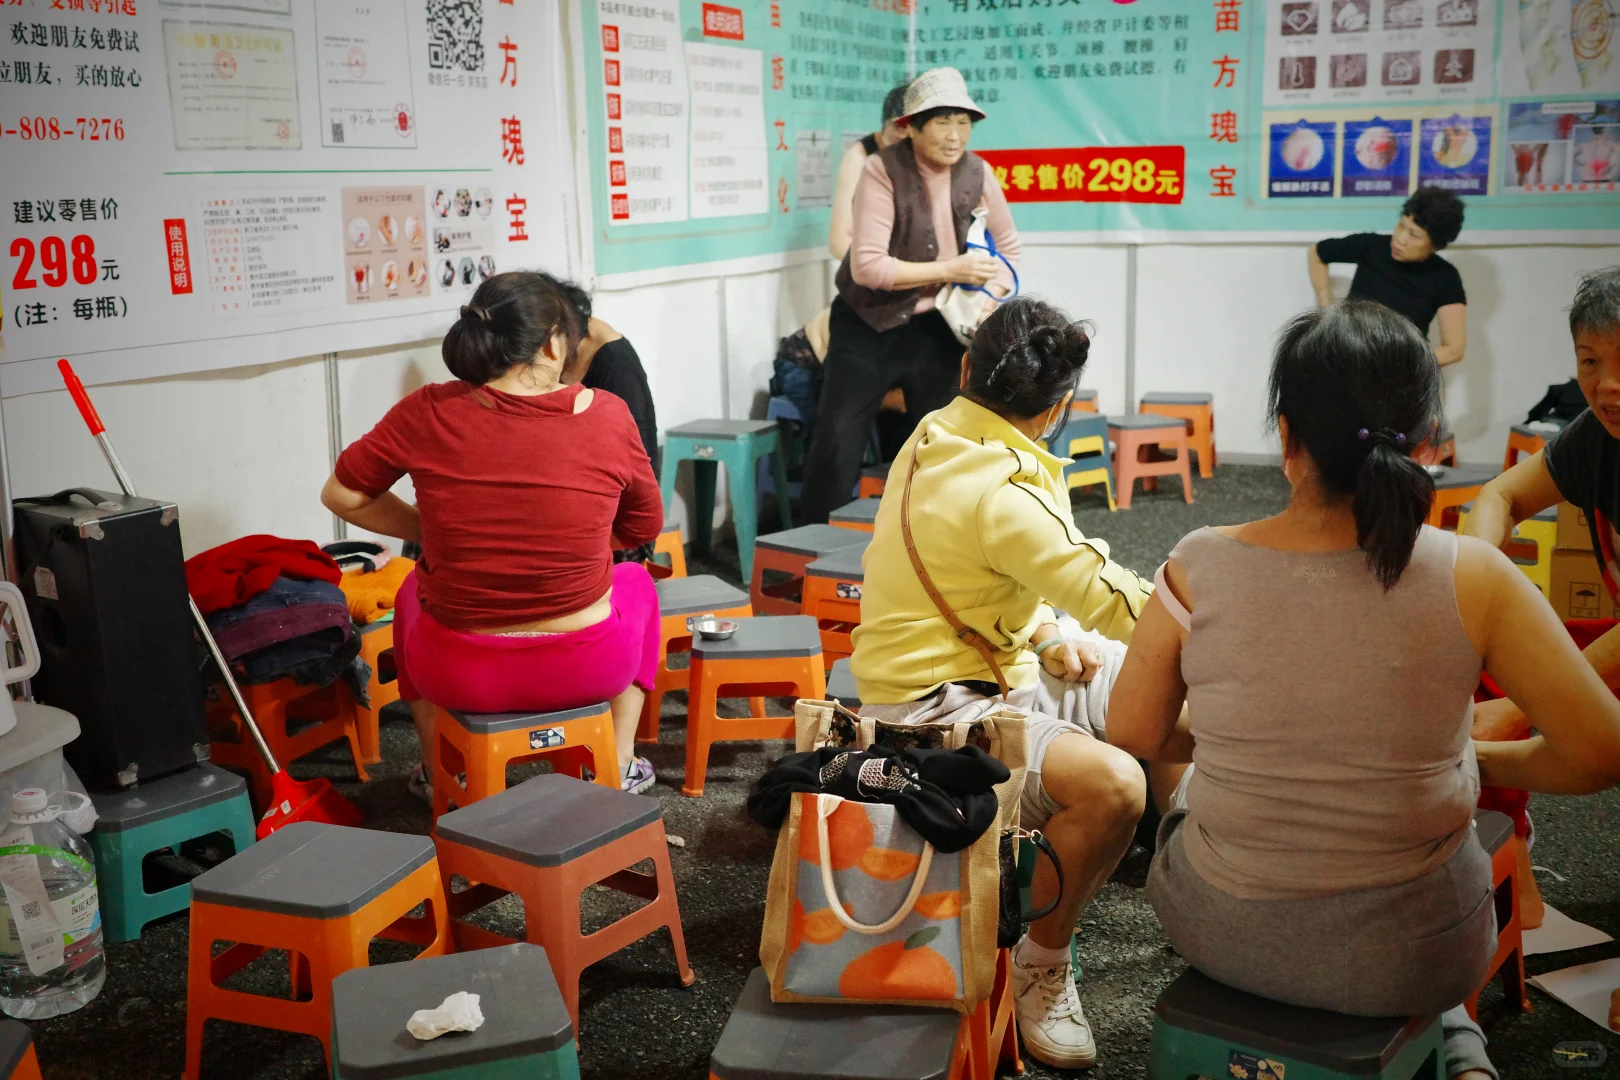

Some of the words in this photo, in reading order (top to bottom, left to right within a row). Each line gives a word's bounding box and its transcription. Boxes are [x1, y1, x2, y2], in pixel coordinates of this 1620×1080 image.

[10, 21, 140, 52] 欢迎朋友免费试
[498, 0, 529, 242] 方瑰宝
[1209, 0, 1243, 198] 苗方瑰宝
[0, 117, 125, 141] -808-7276
[14, 198, 118, 225] 建议零售价
[169, 226, 188, 288] 使用说明
